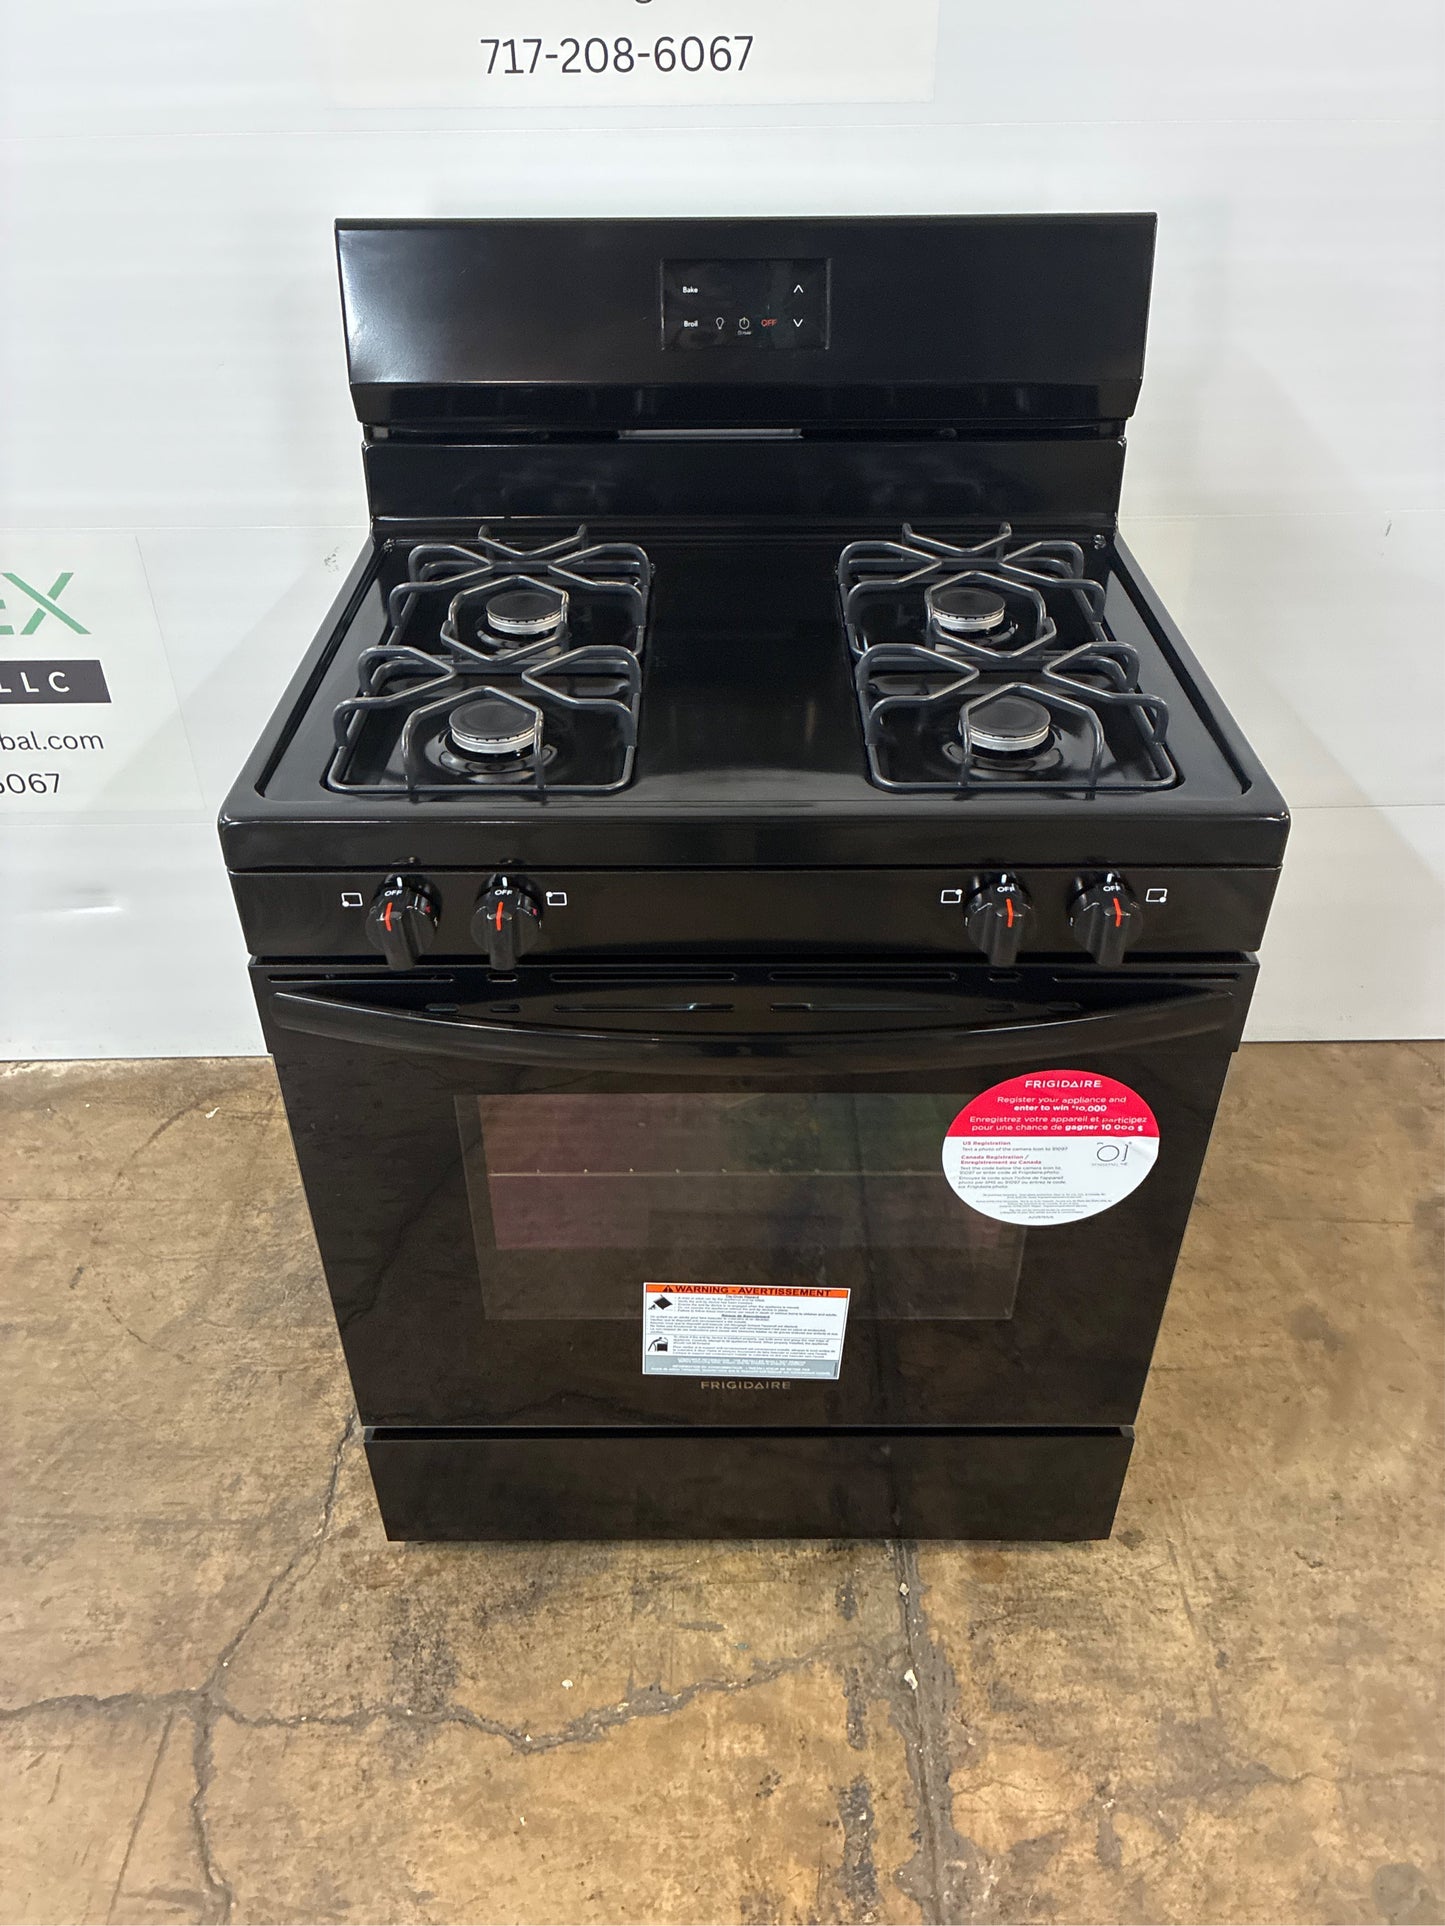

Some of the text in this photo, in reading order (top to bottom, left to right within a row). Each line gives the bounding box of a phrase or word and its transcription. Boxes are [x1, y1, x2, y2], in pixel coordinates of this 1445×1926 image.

[480, 35, 755, 74] 717-208-6067
[682, 286, 699, 294] Bake
[760, 319, 778, 327] OFF
[0, 572, 91, 635] X
[384, 889, 403, 897] OFF
[1024, 1079, 1103, 1089] FRIGIDAIRE
[997, 1096, 1036, 1104] Register
[1062, 1096, 1107, 1104] appliance
[969, 1116, 1022, 1124] Enregistrez
[1050, 1116, 1088, 1124] appareil
[1137, 1125, 1144, 1133] $
[675, 1285, 730, 1295] WARNING
[738, 1287, 832, 1297] AVERTISSEMENT
[700, 1380, 792, 1390] FRIGIDAIRE
